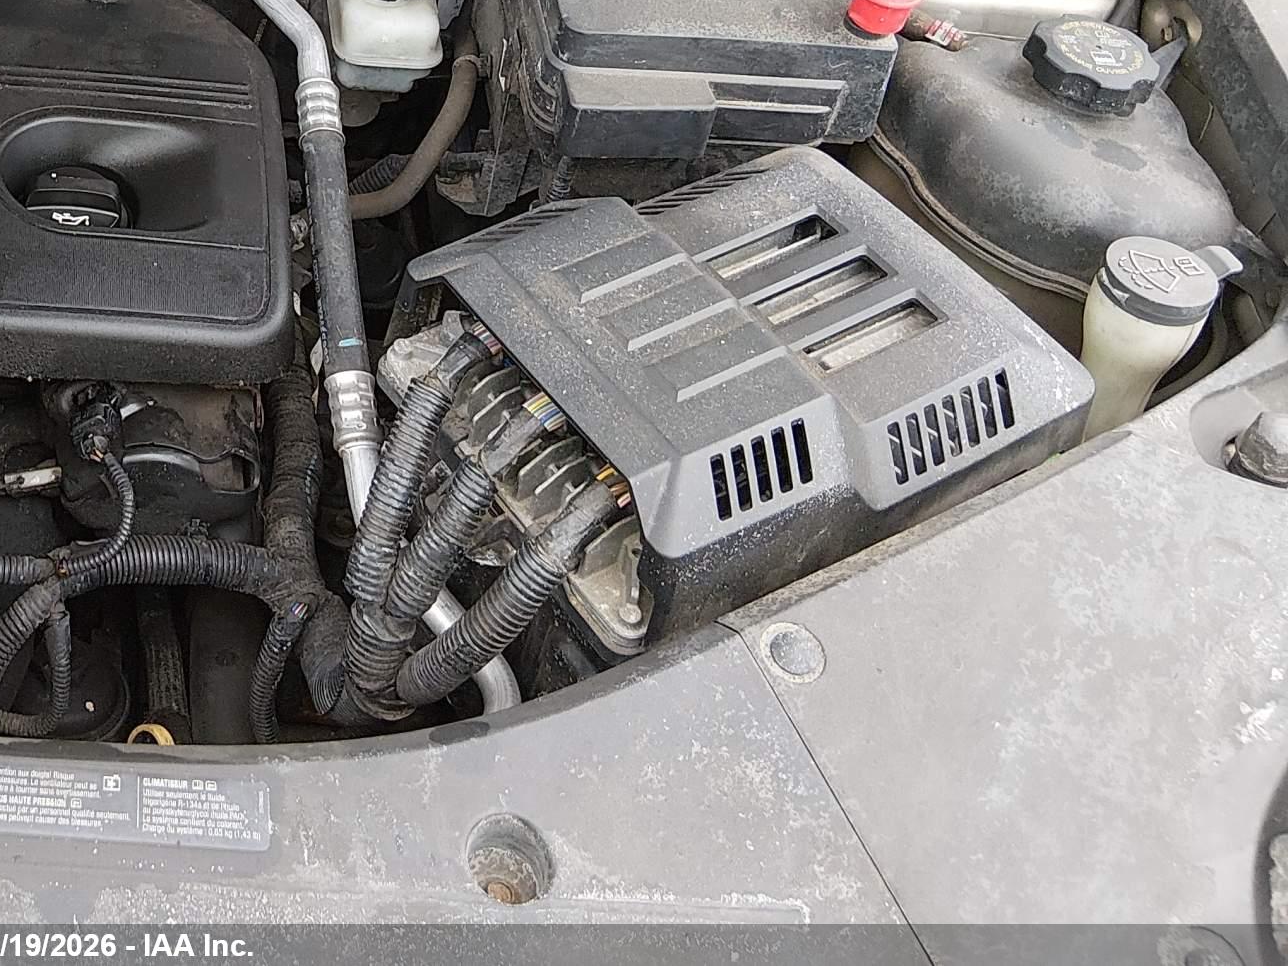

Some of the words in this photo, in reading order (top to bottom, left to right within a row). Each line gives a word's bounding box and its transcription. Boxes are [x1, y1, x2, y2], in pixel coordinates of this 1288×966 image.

[143, 778, 188, 789] CLIMATISEUR
[9, 795, 31, 805] HAUTE
[33, 796, 66, 807] PRESSION
[58, 816, 69, 824] des
[224, 830, 233, 838] kg
